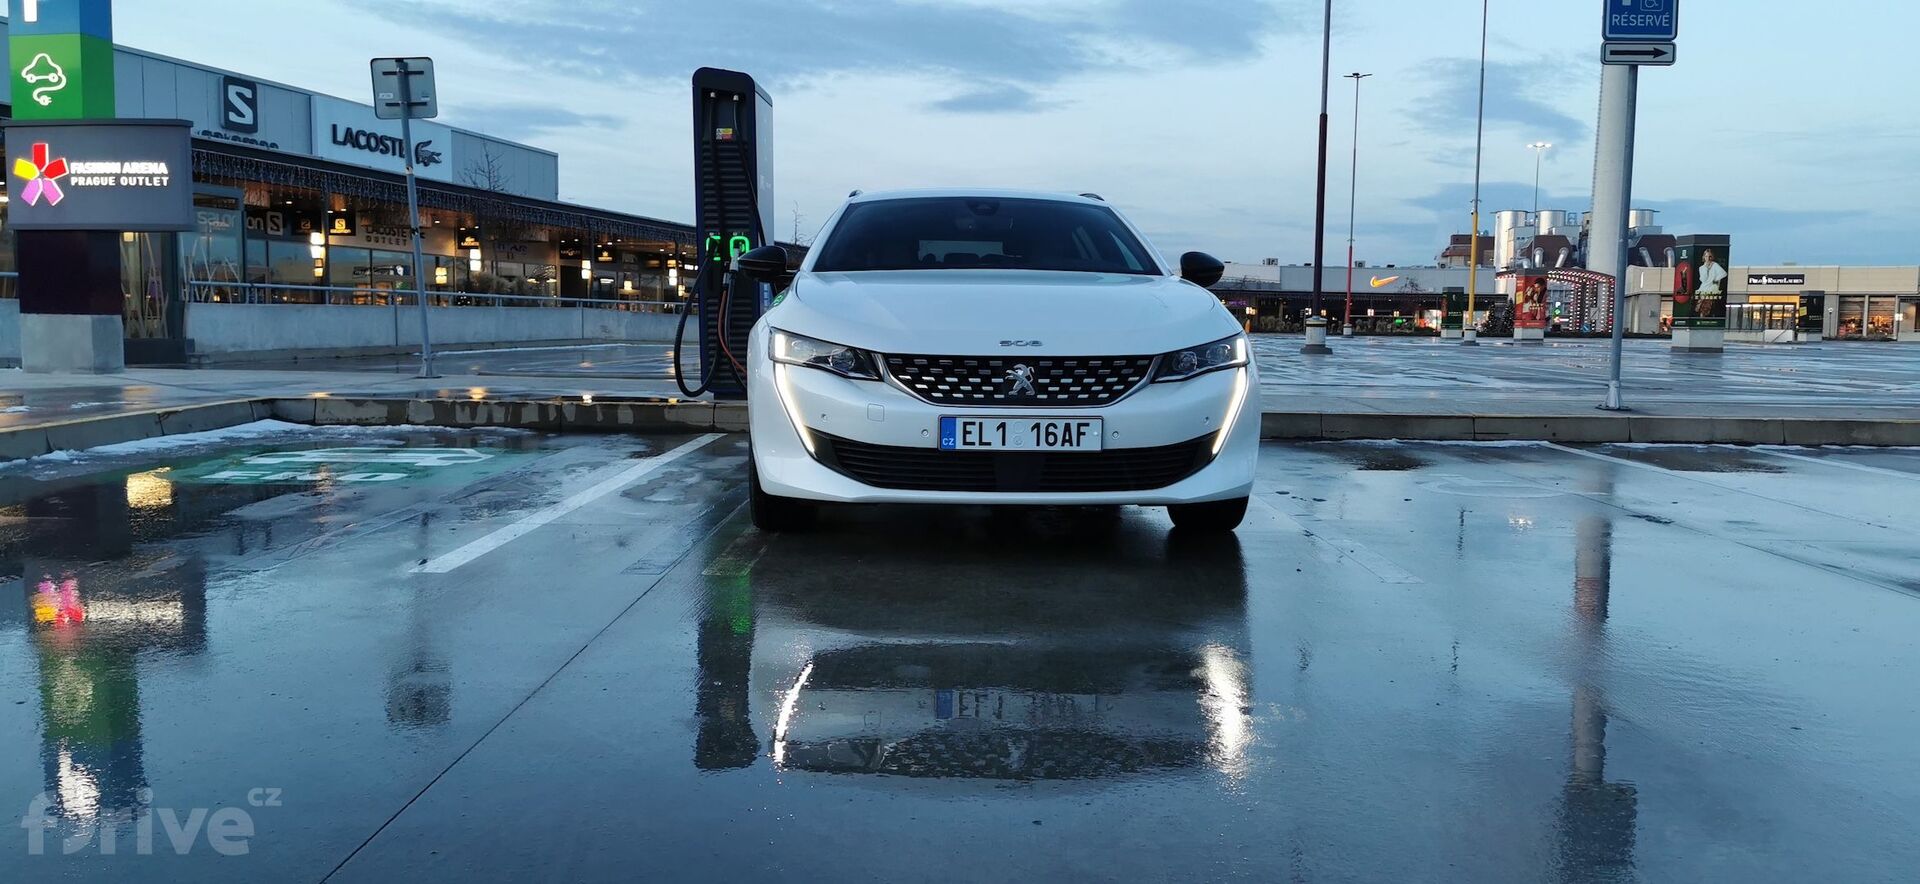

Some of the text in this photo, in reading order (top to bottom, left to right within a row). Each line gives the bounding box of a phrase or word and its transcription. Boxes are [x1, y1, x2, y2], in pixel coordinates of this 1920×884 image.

[1612, 11, 1670, 27] RÉSERVÉ
[70, 161, 169, 175] FASHION ARENA
[70, 176, 169, 187] PRAGUE OUTLET
[366, 225, 407, 238] LACOSTE
[365, 235, 408, 246] OUTLET
[942, 421, 1090, 447] CZ EL1 16AF
